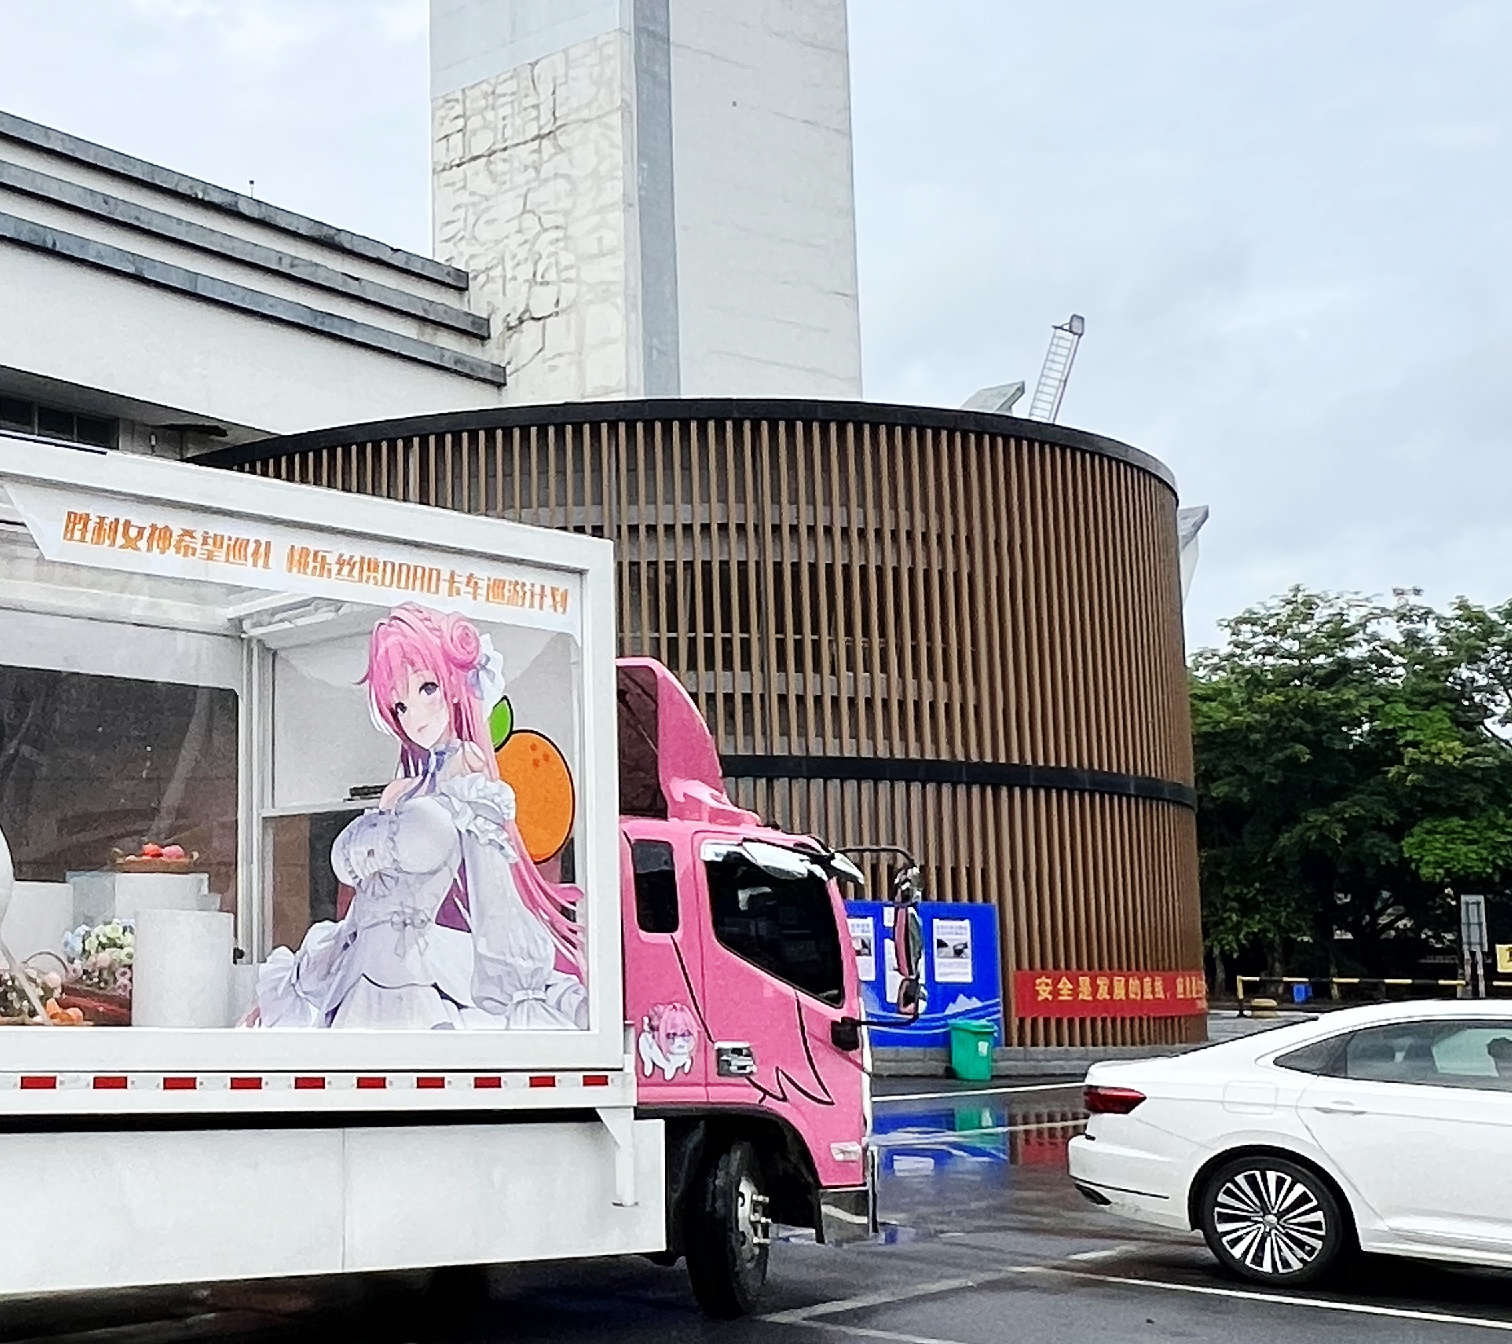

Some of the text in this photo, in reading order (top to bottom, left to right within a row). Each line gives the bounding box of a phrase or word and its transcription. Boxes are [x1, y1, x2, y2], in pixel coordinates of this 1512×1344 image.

[63, 511, 271, 569] 胜利女神希望巡礼
